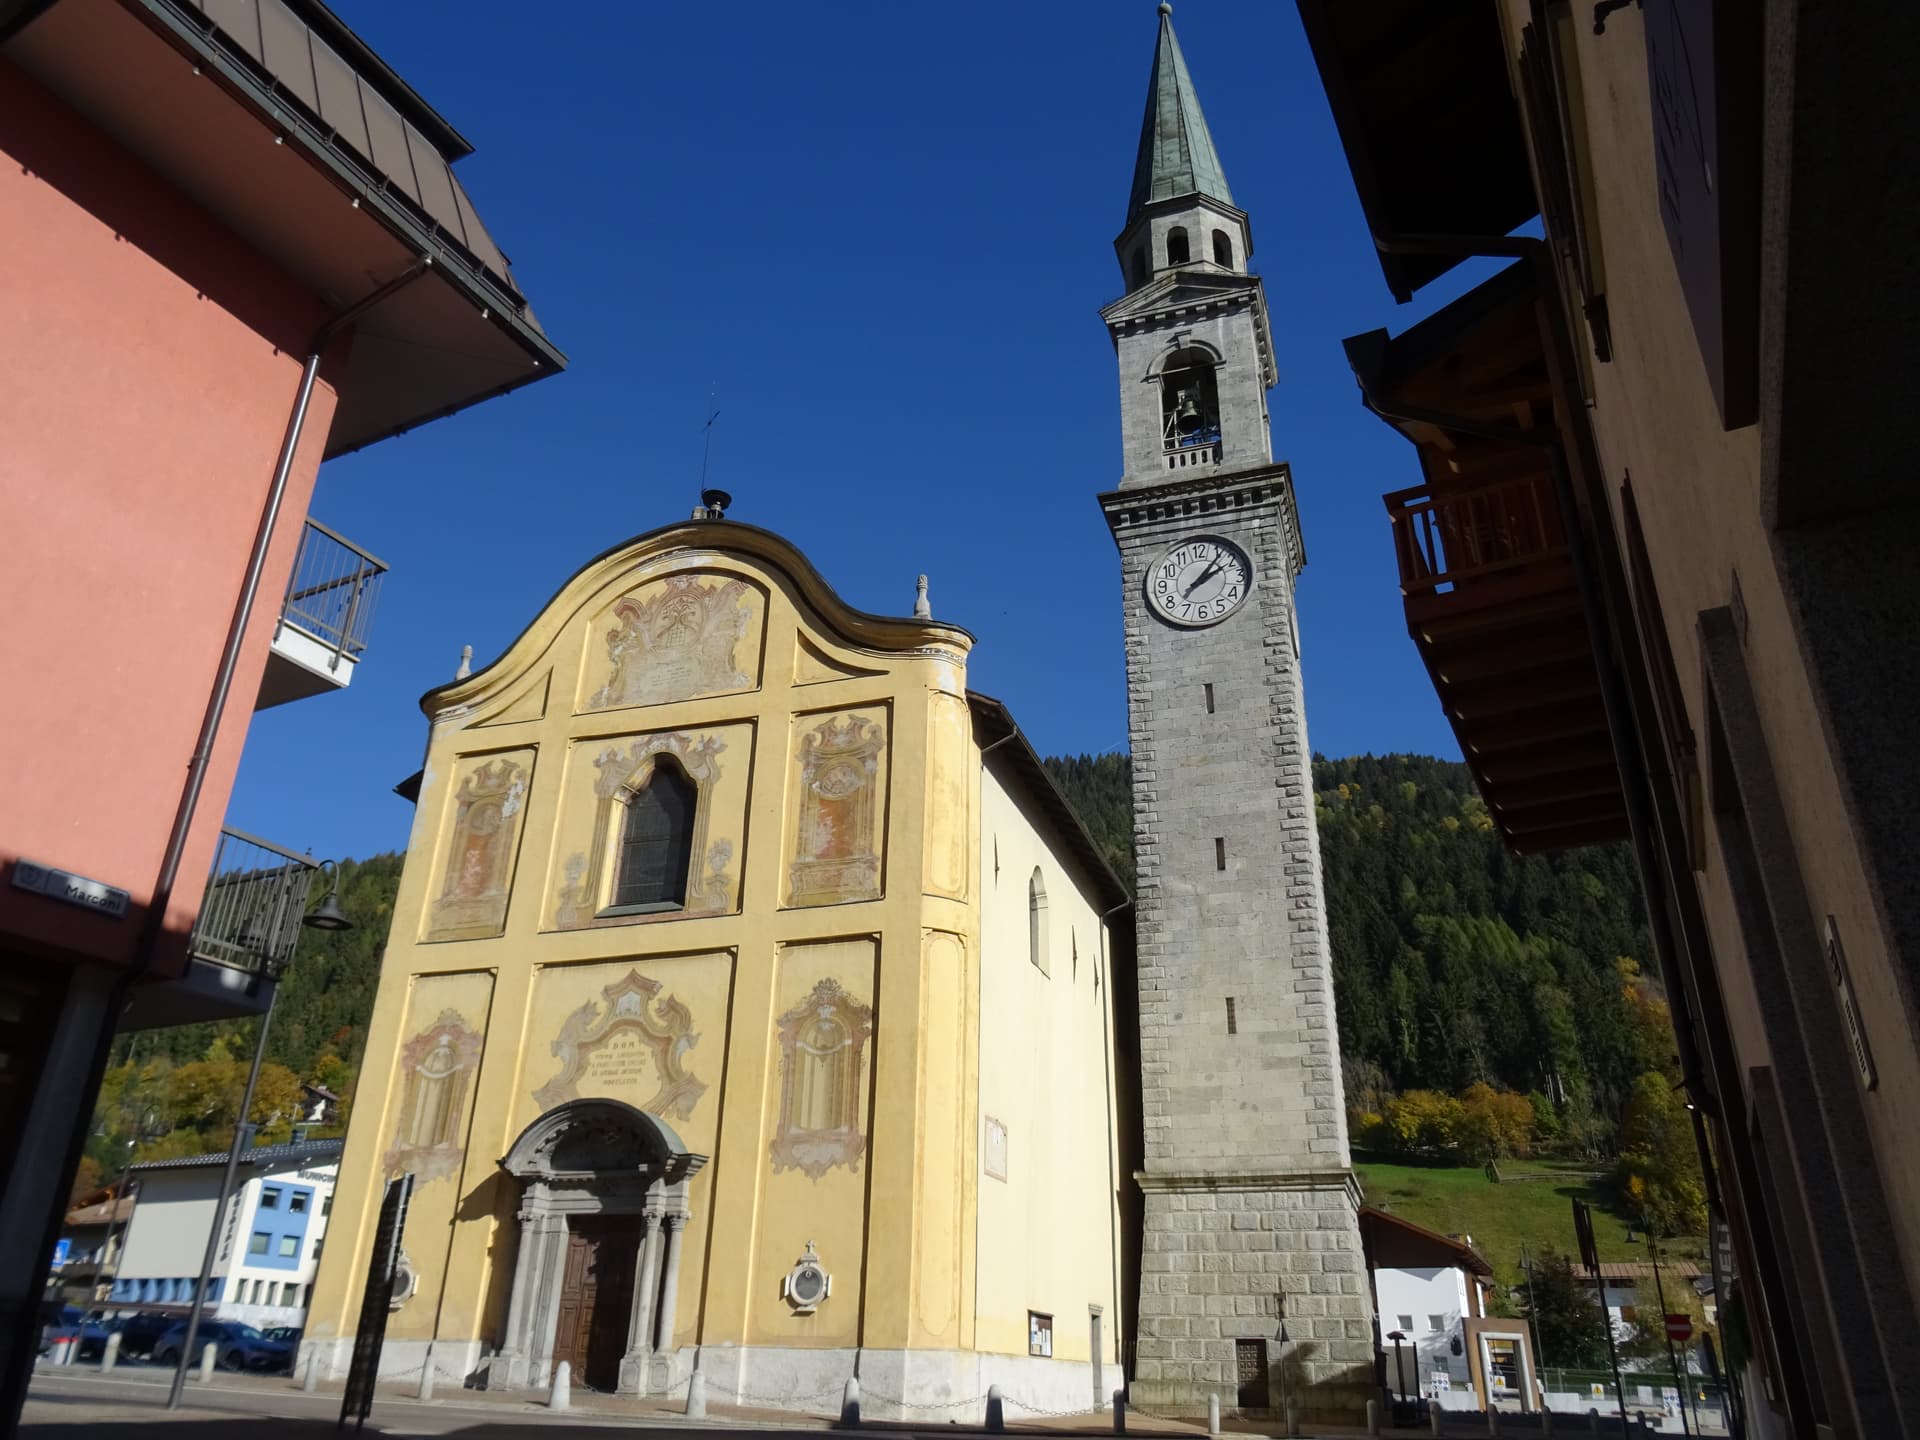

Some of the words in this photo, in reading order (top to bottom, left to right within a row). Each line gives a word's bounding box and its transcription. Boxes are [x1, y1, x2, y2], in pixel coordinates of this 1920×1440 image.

[1176, 551, 1186, 565] 11
[1193, 544, 1205, 558] 12
[1227, 553, 1236, 567] 2
[1163, 564, 1175, 577] 10
[1236, 568, 1244, 583] 3
[1158, 581, 1167, 594] 9
[1228, 586, 1237, 600] 4
[1166, 596, 1175, 609] 8
[1216, 599, 1225, 613] 5
[1182, 604, 1191, 617] 7
[1199, 605, 1207, 619] 6
[64, 884, 121, 910] Marconi
